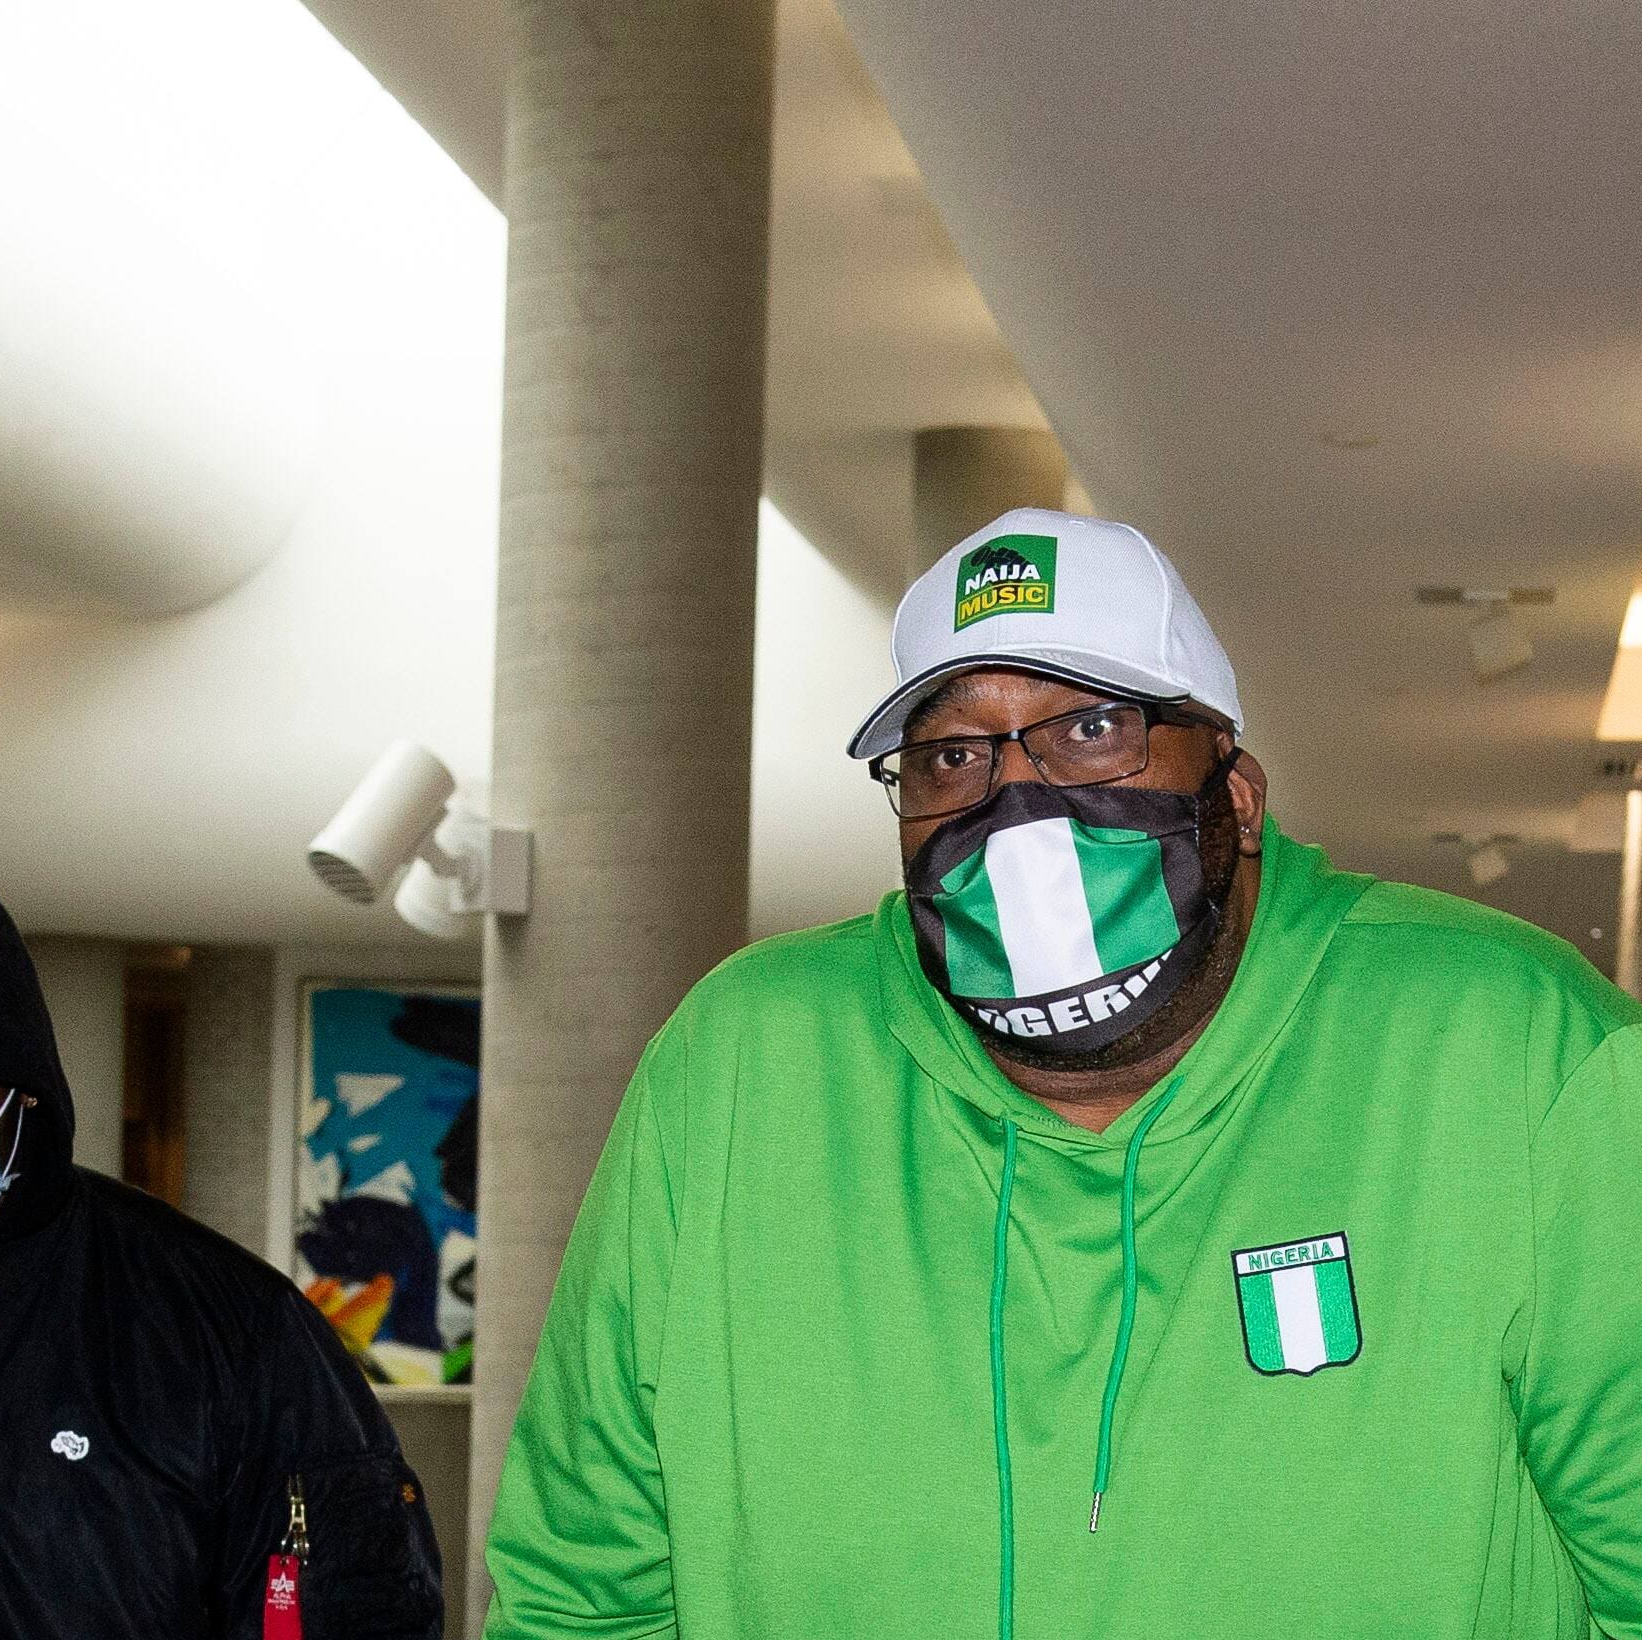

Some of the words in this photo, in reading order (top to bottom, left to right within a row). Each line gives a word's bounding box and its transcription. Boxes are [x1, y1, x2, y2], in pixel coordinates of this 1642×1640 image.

[965, 564, 1041, 595] NAIJA
[961, 586, 1044, 620] MUSIC
[1248, 1241, 1334, 1271] NIGERIA
